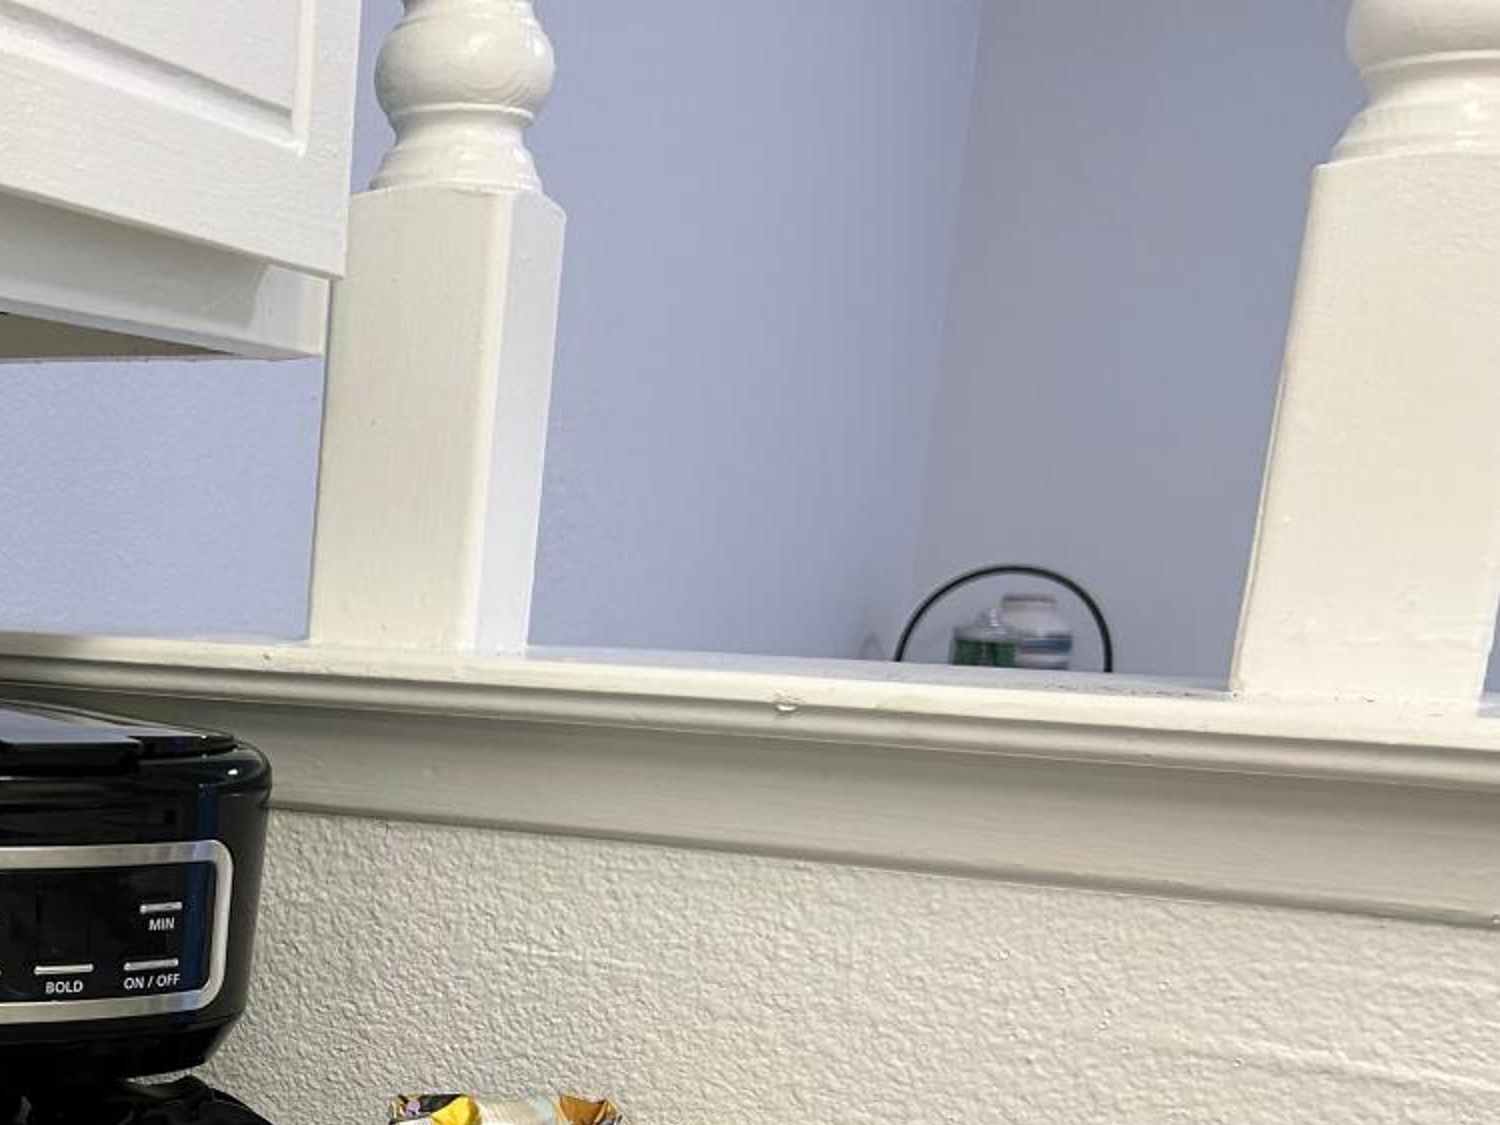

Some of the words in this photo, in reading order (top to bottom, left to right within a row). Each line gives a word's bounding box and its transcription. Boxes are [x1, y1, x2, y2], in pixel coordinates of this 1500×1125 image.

[148, 917, 175, 931] MIN
[45, 980, 84, 995] BOLD
[123, 976, 144, 990] ON
[156, 973, 181, 988] OFF
